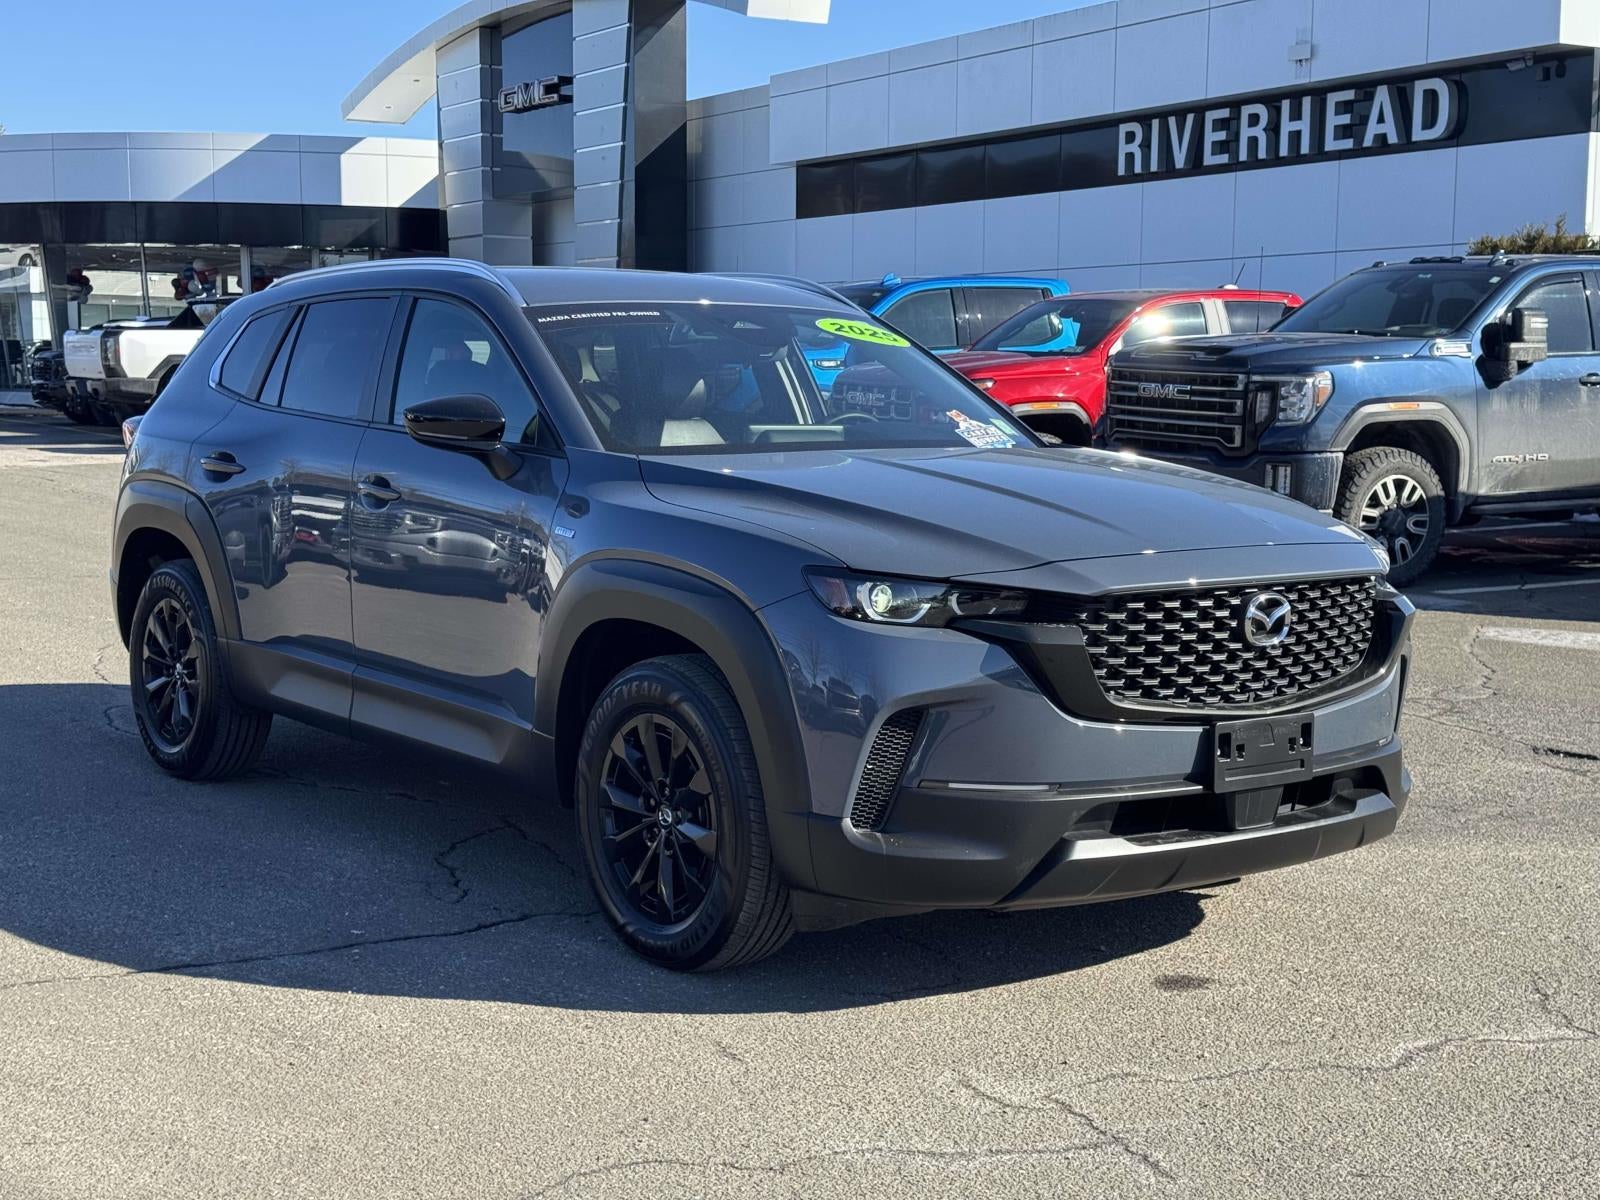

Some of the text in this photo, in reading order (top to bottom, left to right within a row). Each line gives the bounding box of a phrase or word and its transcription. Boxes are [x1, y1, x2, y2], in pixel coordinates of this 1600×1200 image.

[498, 75, 559, 113] GMC
[1117, 77, 1451, 177] RIVERHEAD
[830, 322, 898, 342] 2025
[848, 391, 885, 406] GMC
[1138, 383, 1191, 400] GMC
[1524, 453, 1550, 462] HD
[583, 680, 662, 751] GOODYEAR
